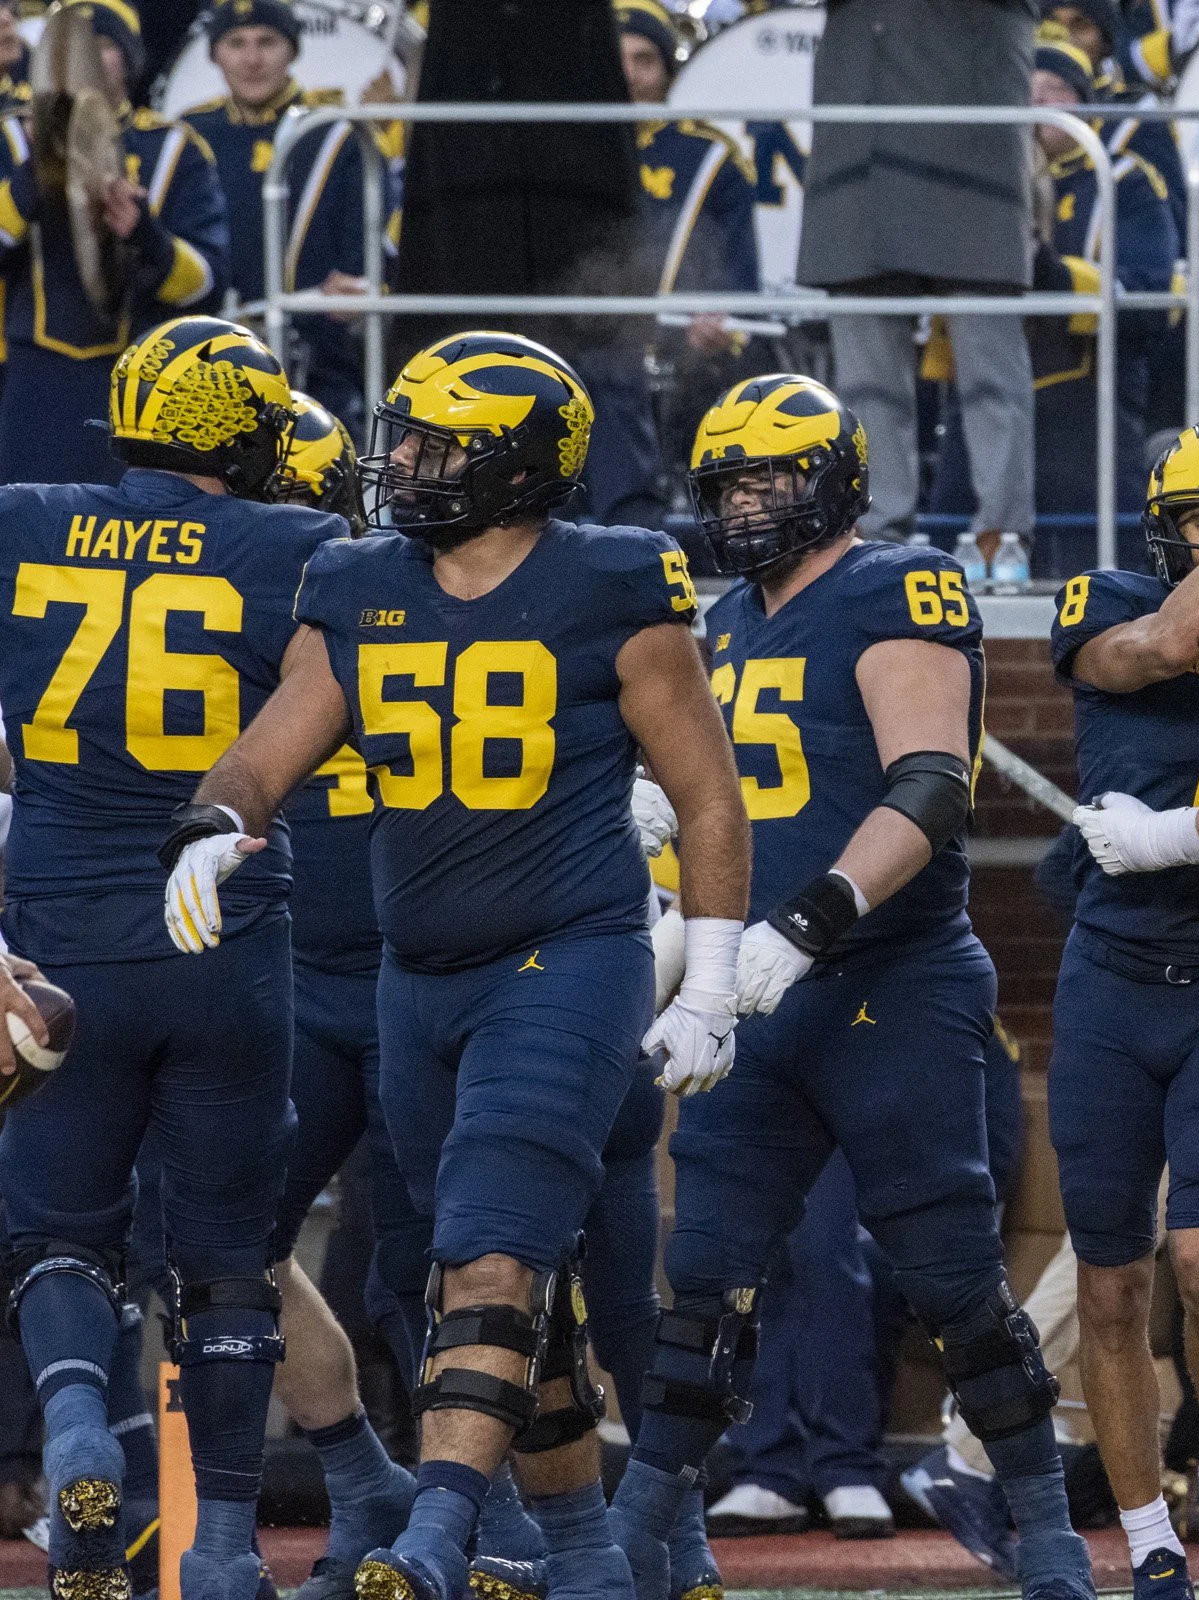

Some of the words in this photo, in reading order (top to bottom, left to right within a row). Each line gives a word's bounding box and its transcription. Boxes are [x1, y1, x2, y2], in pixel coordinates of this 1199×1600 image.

[65, 515, 206, 565] HAYES
[904, 570, 970, 627] 65
[1060, 575, 1091, 628] 8
[11, 562, 244, 772] 76
[358, 640, 557, 811] 58
